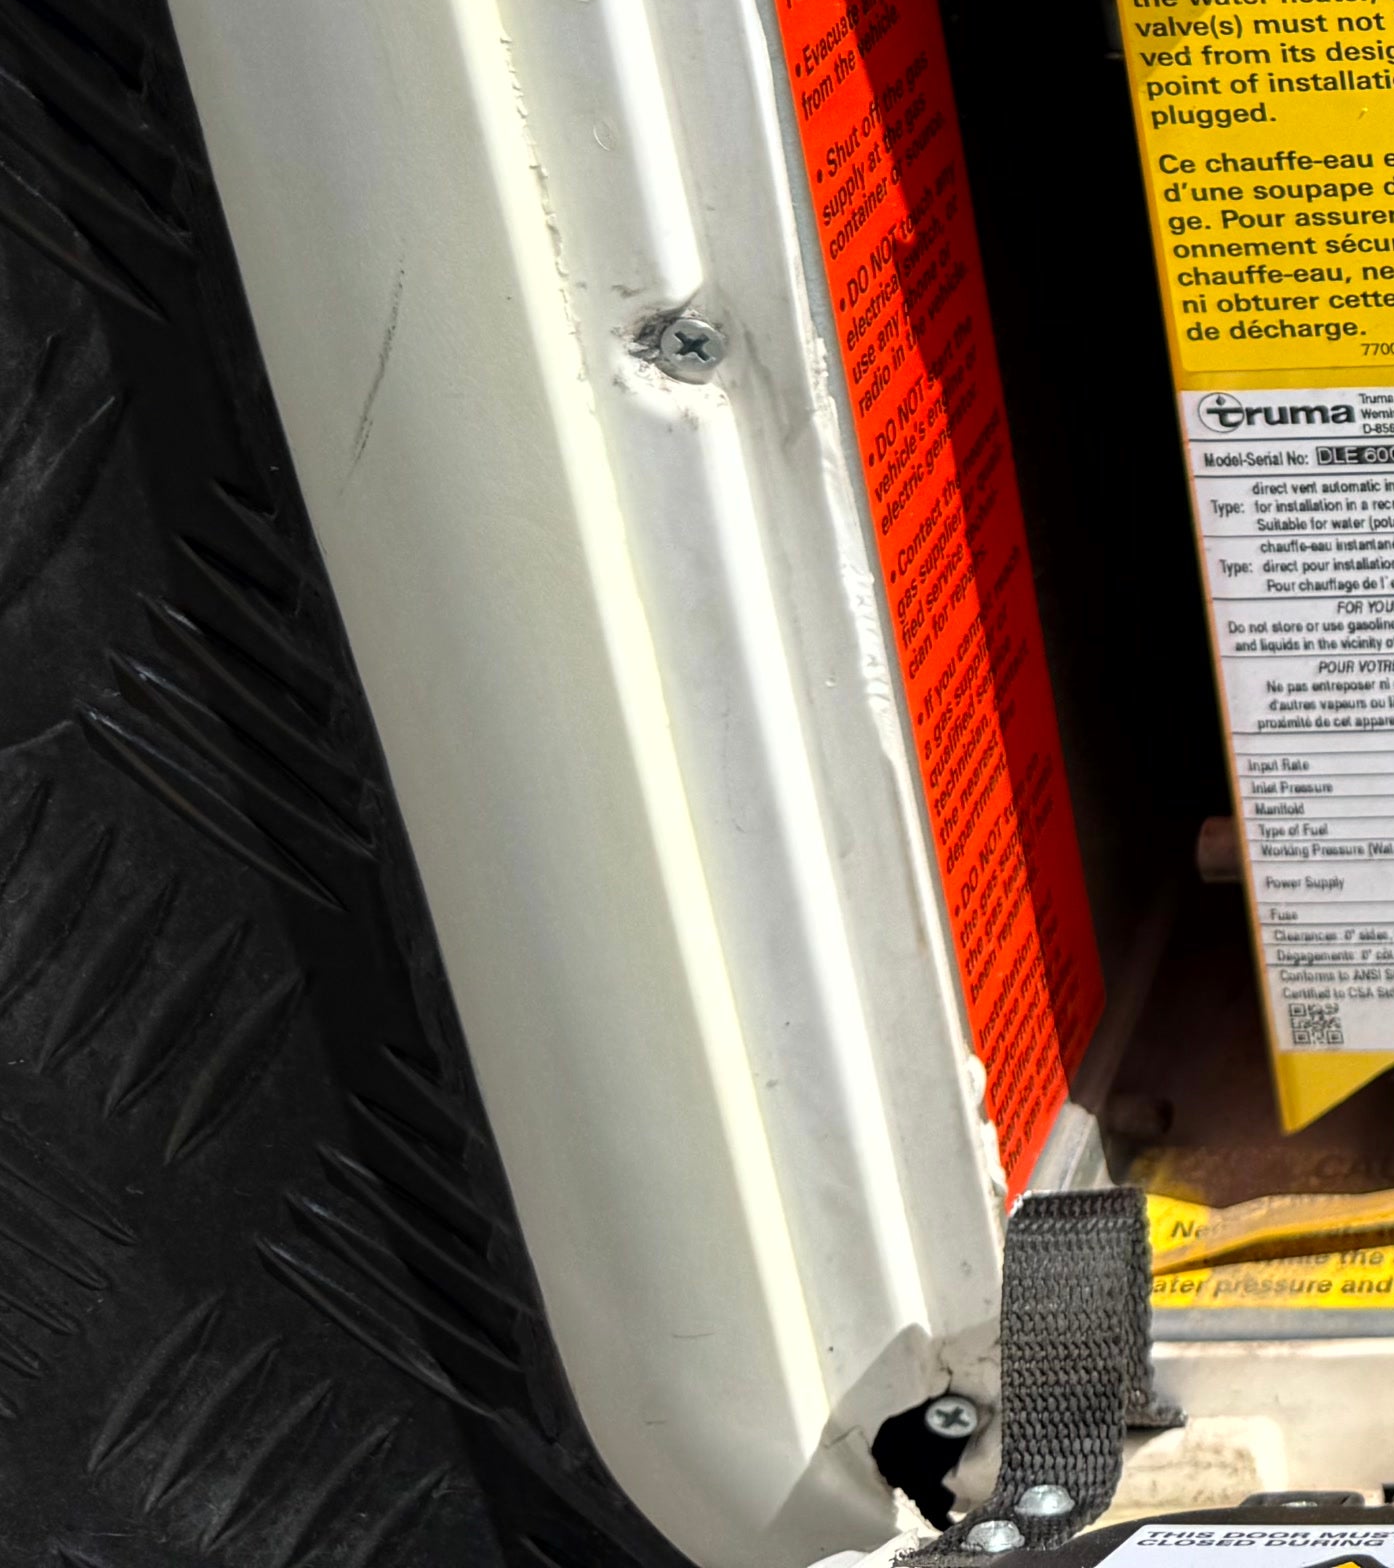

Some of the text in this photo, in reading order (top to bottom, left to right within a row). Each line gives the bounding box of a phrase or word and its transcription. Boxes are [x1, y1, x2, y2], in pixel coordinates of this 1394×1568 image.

[1135, 15, 1242, 39] valve(s)
[1254, 15, 1328, 34] must
[1338, 13, 1385, 31] not
[1139, 46, 1191, 67] ved
[1201, 45, 1270, 65] from
[1280, 43, 1315, 63] its
[1146, 75, 1221, 101] point
[1230, 73, 1258, 94] of
[1151, 102, 1276, 129] plugged.
[1159, 154, 1195, 174] Ce
[1206, 151, 1373, 172] chauffe-eau
[1164, 183, 1243, 202] d'une
[1253, 182, 1373, 203] soupape
[1168, 216, 1210, 235] ge.
[1221, 210, 1285, 229] Pour
[1173, 238, 1317, 258] onnement
[1178, 265, 1351, 286] chauffe-eau,
[1362, 266, 1394, 280] ne
[1183, 294, 1207, 313] ni
[1217, 293, 1319, 312] obturer
[1187, 319, 1366, 341] de décharge.
[1358, 393, 1394, 404] Truma
[1199, 392, 1356, 432] truma
[1204, 452, 1283, 467] Model-Serial
[1286, 451, 1308, 465] No:
[1318, 446, 1358, 465] DLE
[1252, 482, 1287, 495] direct
[1291, 482, 1317, 494] vent
[1322, 481, 1380, 493] automatic
[1337, 601, 1363, 614] FOR
[1340, 1246, 1384, 1266] the
[1213, 1278, 1331, 1301] pressure
[1340, 1275, 1392, 1293] and
[1136, 1539, 1255, 1547] CLOSED
[1261, 1539, 1384, 1547] DURING
[1147, 1531, 1215, 1539] THIS
[1222, 1531, 1311, 1539] DOOR
